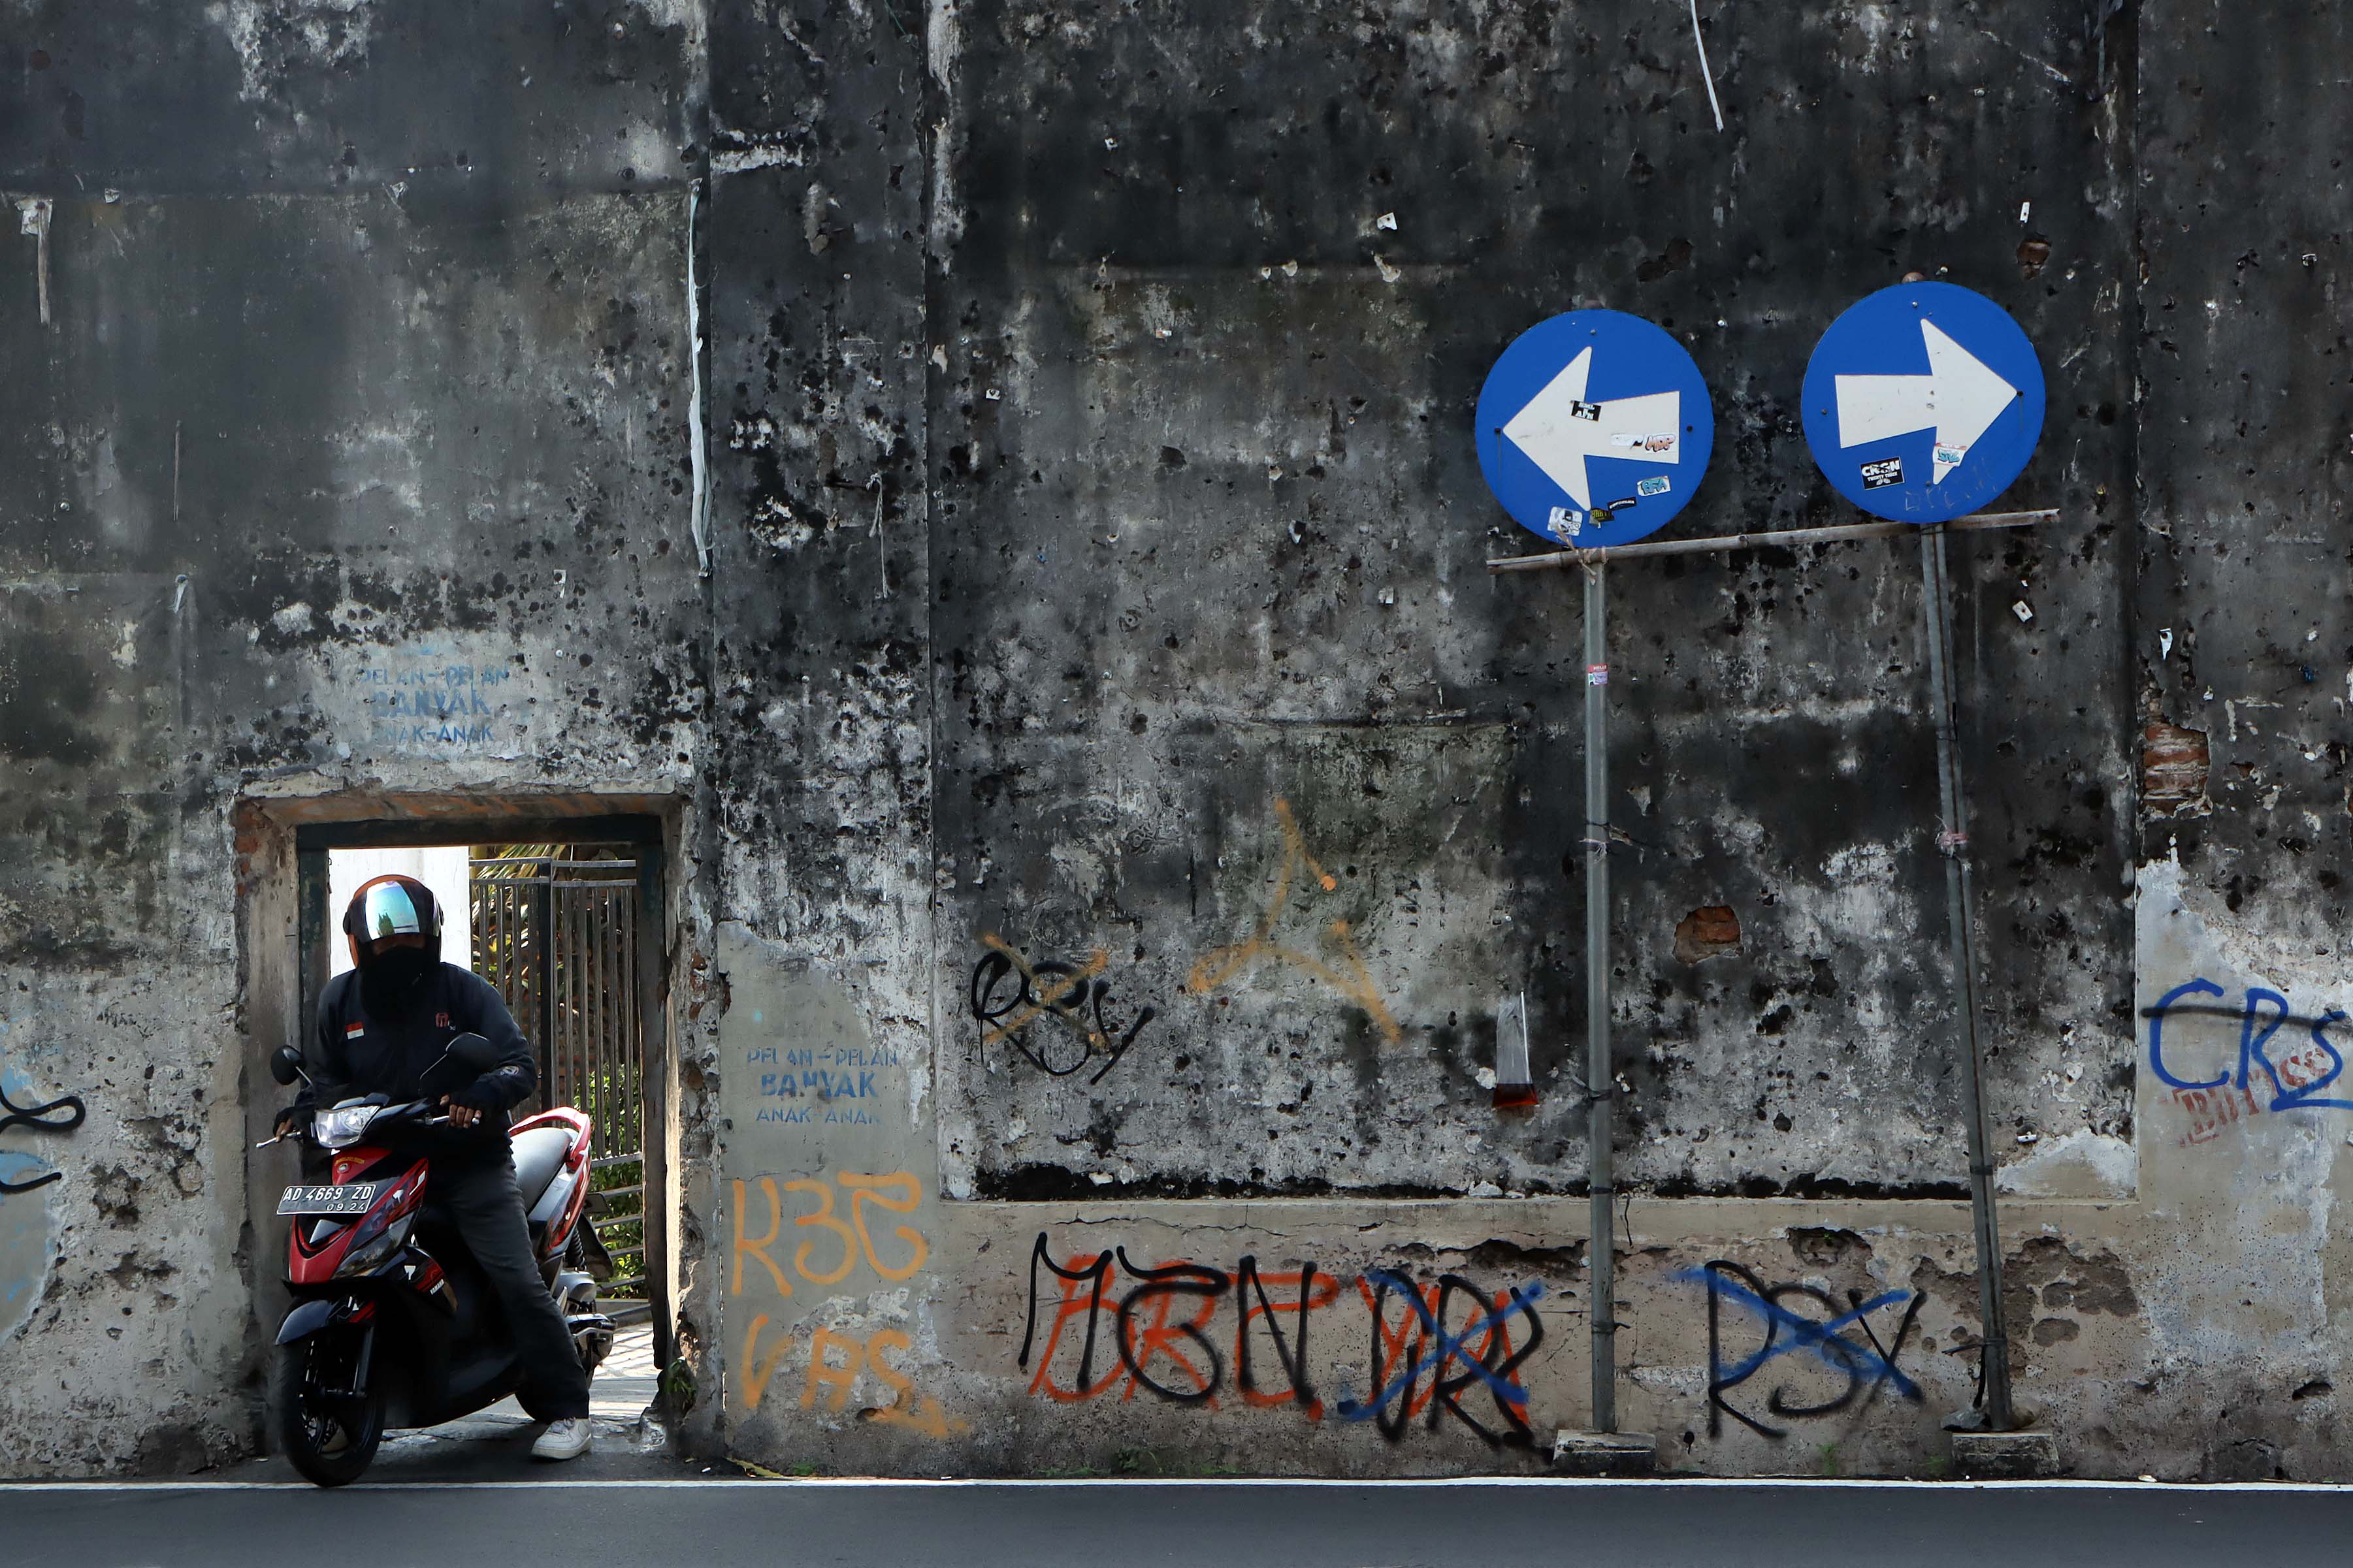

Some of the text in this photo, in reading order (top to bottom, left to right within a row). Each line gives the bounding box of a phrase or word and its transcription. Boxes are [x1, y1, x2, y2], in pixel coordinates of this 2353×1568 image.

[372, 688, 490, 717] BANYAK
[373, 724, 495, 743] NAK-ANAK
[2149, 978, 2353, 1112] CRS
[760, 1068, 879, 1098] BANYAK
[282, 1185, 372, 1202] AD 4669 ZD
[327, 1202, 366, 1211] 09 24
